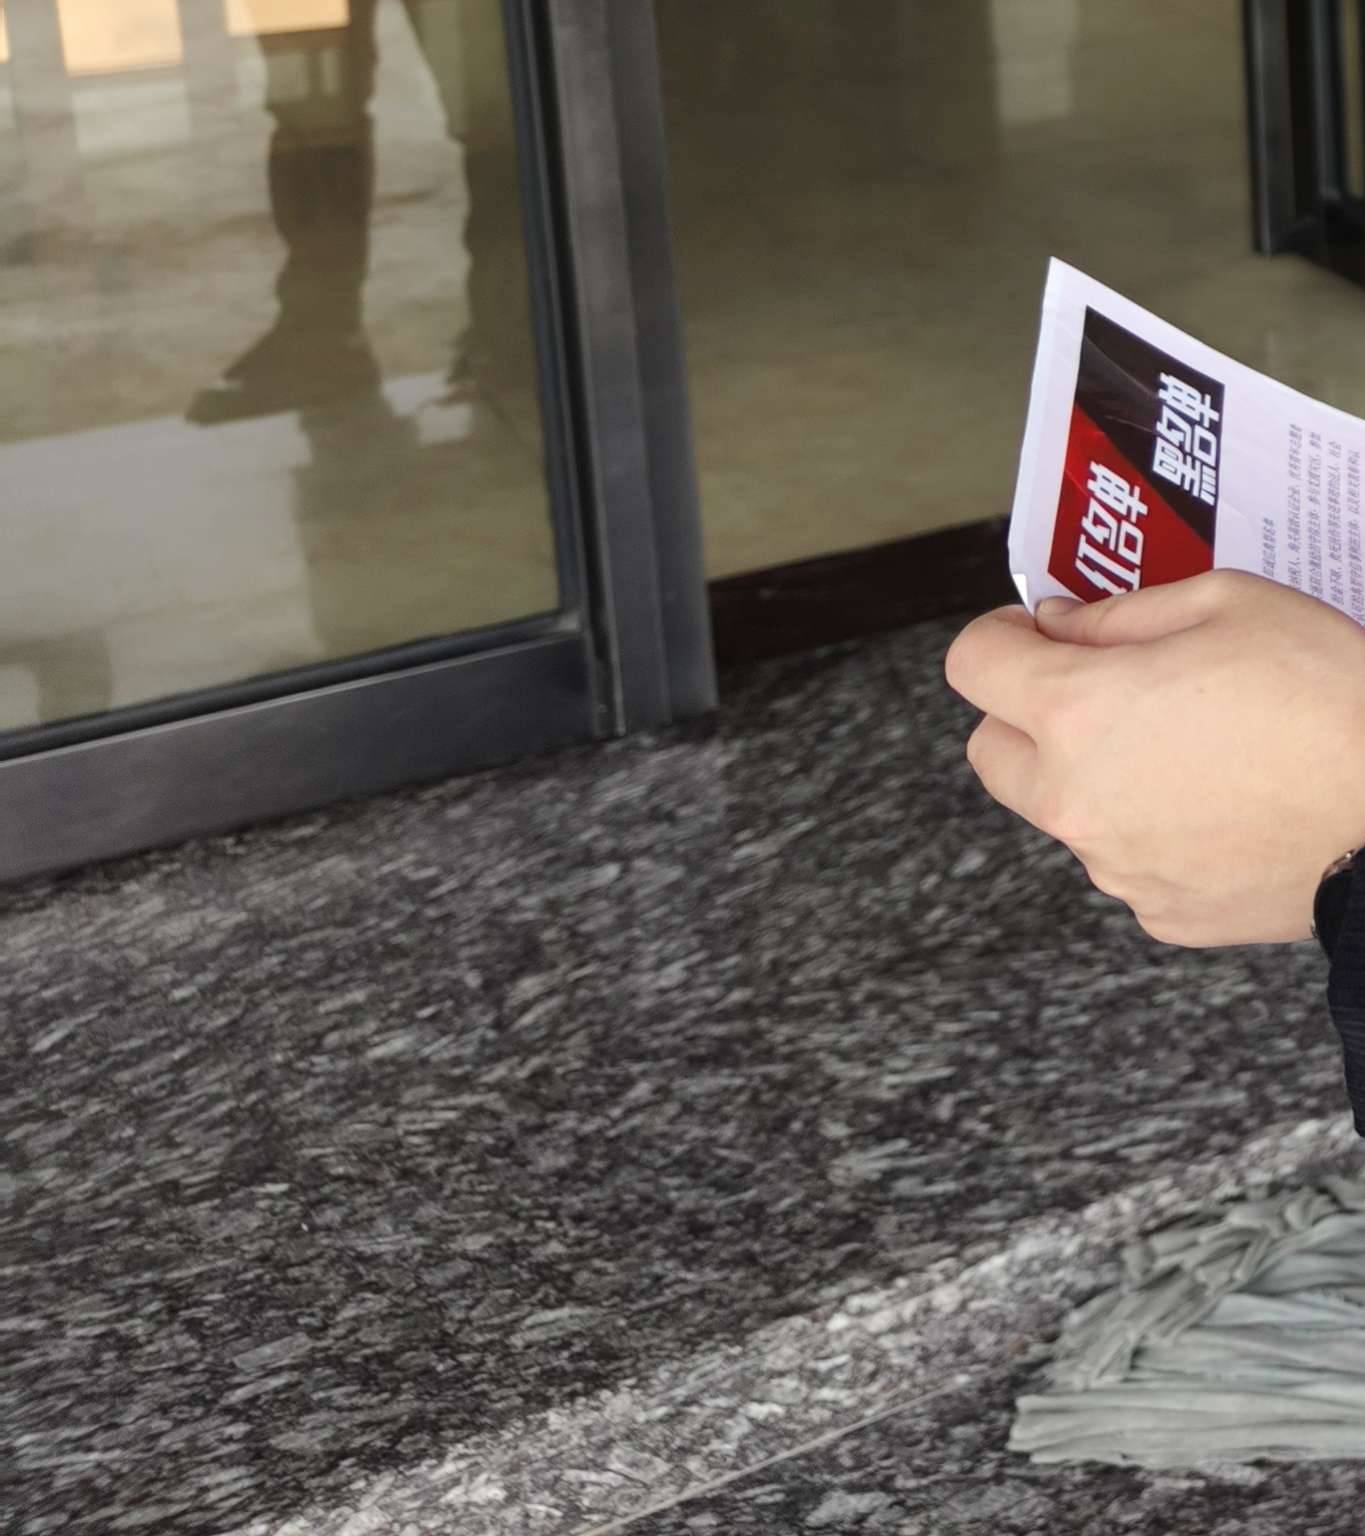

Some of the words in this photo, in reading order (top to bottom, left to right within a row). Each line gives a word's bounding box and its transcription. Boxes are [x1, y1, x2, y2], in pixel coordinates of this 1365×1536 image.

[1151, 372, 1220, 506] 黑名单
[1074, 460, 1149, 595] 红名单
